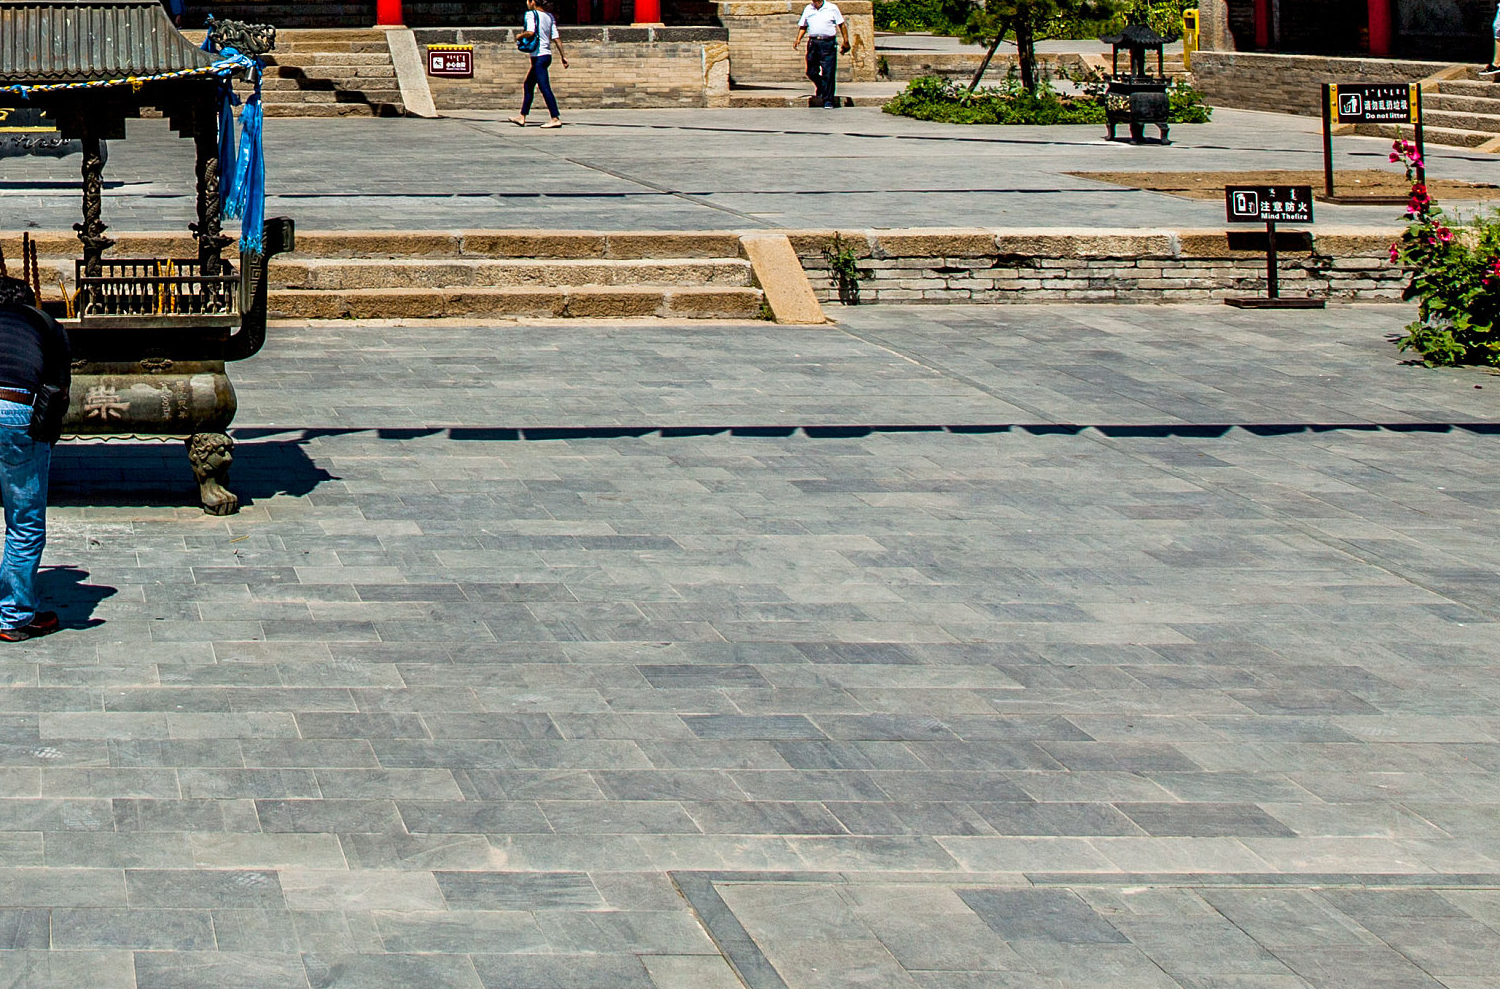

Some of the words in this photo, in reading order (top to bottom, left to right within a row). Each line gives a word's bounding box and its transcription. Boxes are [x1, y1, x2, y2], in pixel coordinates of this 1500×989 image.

[1260, 200, 1308, 212] 注意防火
[1260, 212, 1280, 220] Mind
